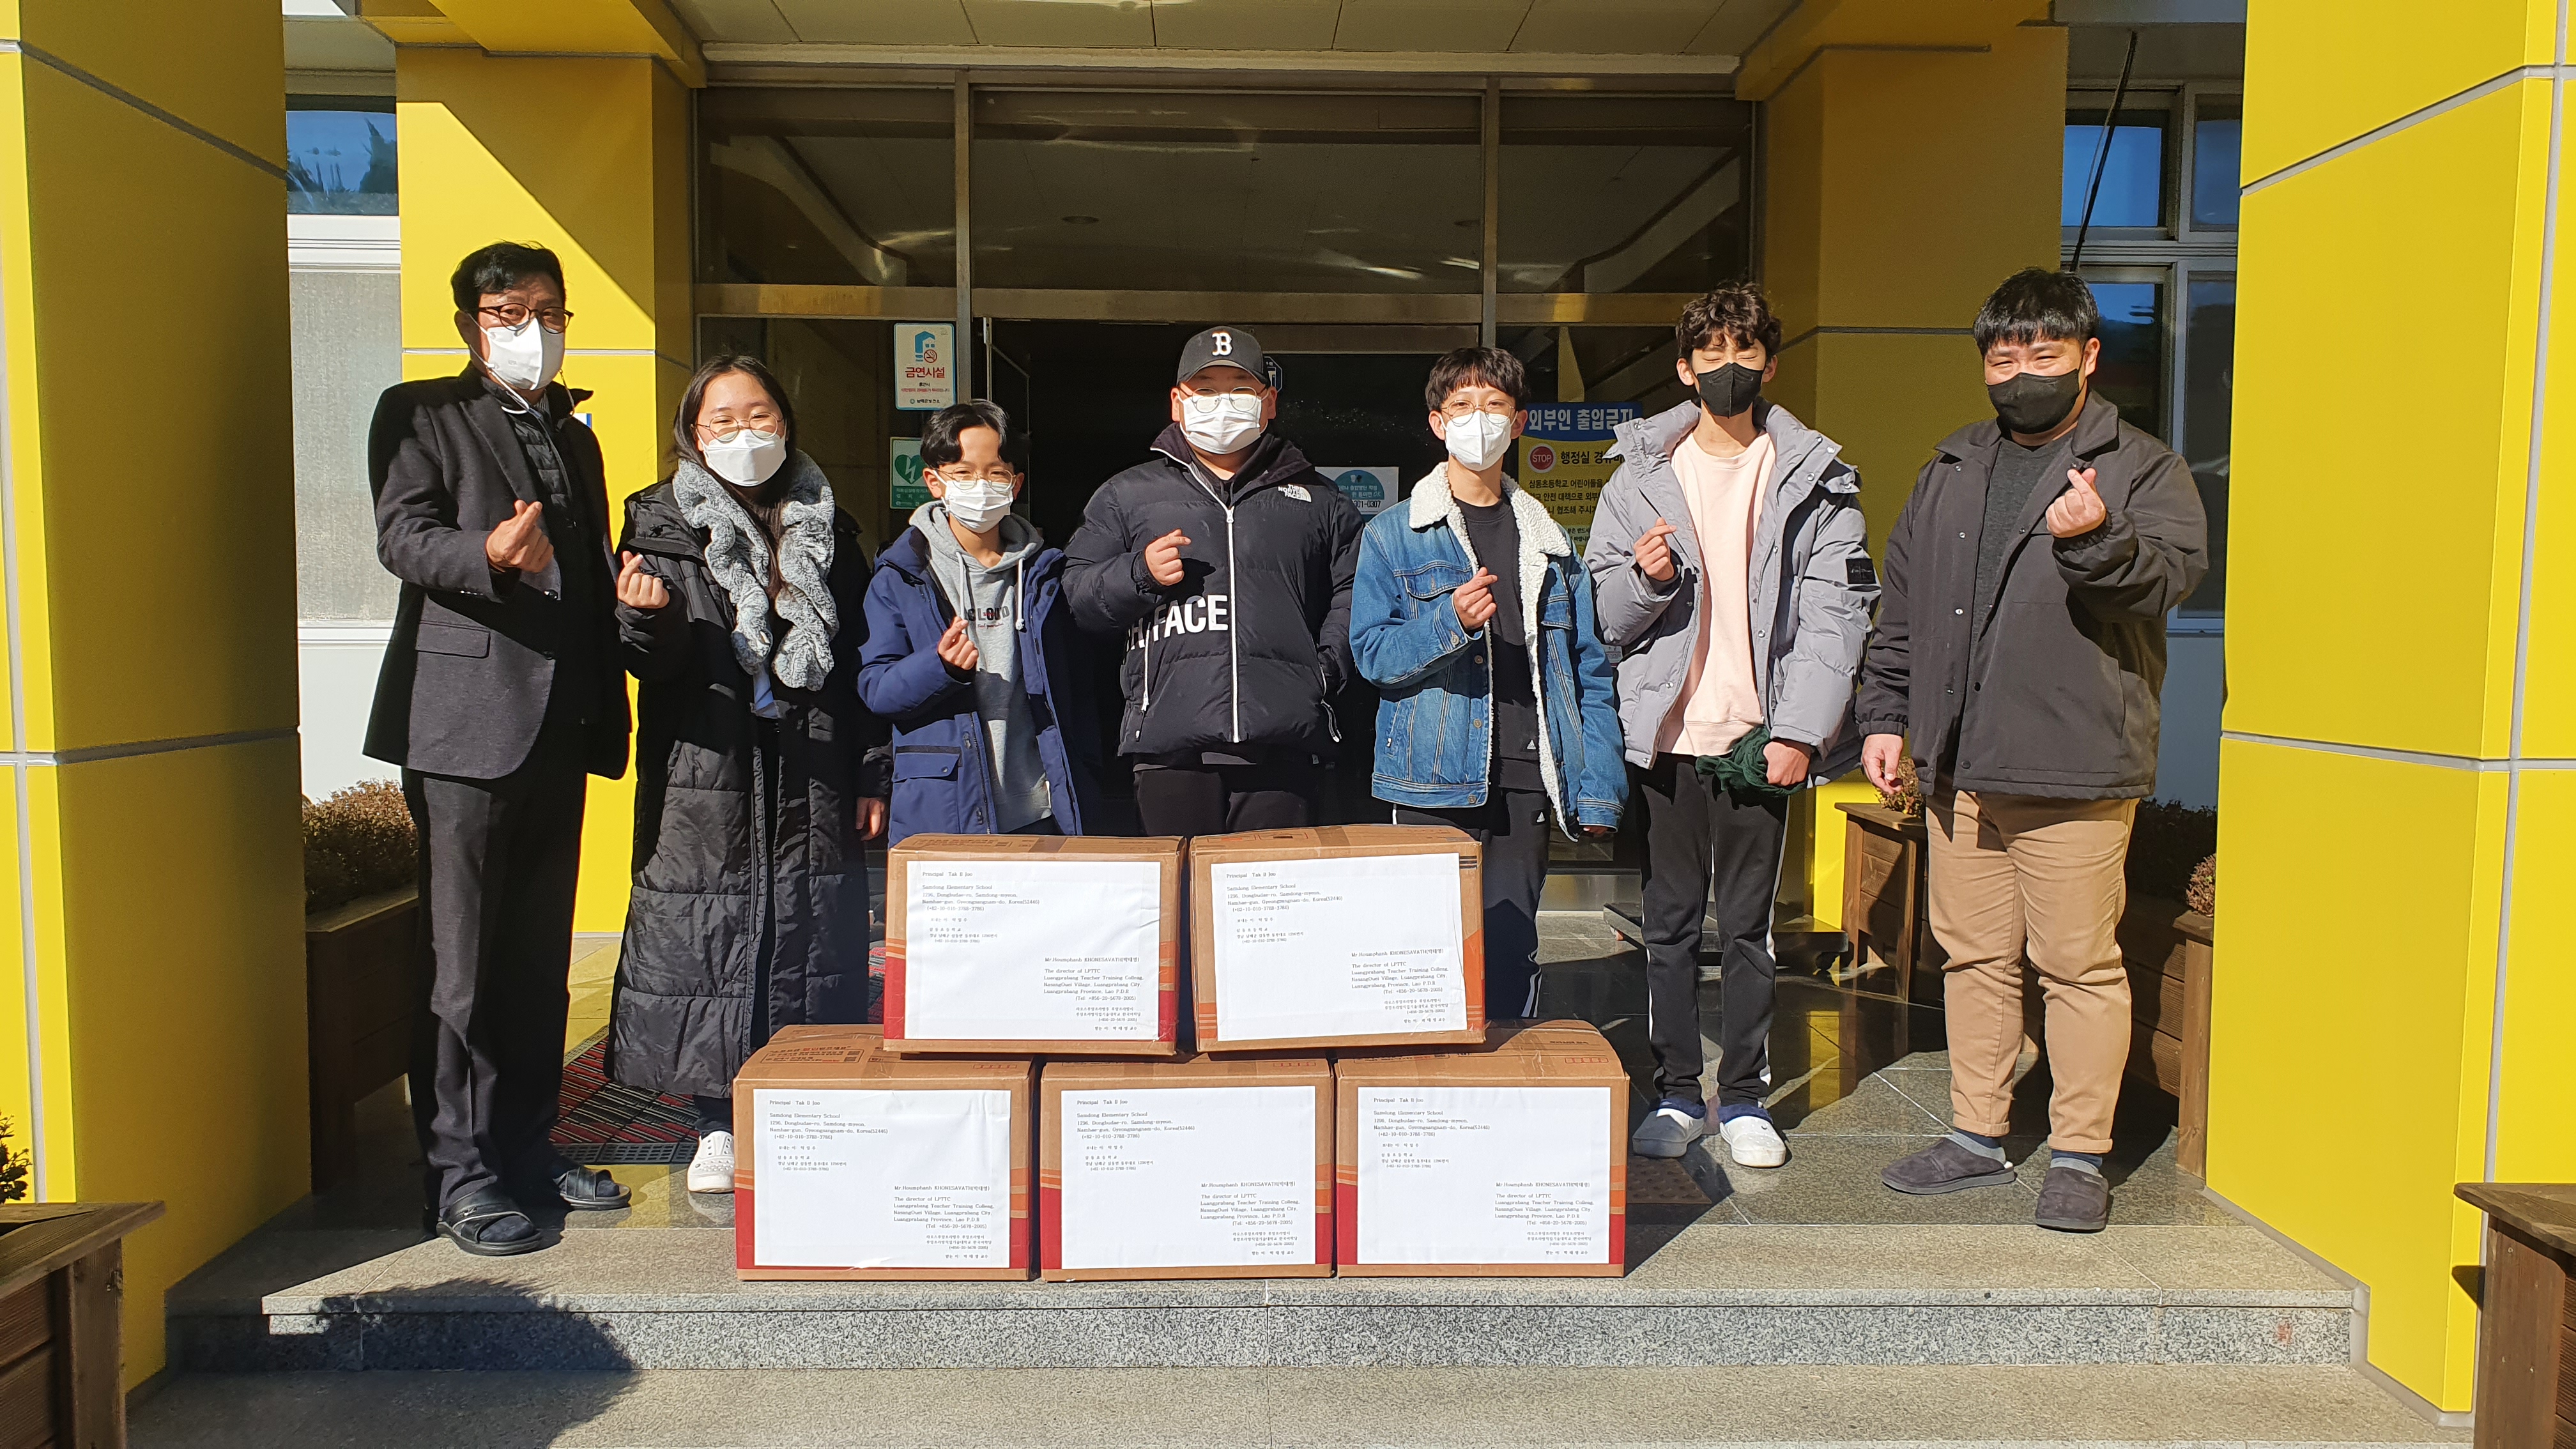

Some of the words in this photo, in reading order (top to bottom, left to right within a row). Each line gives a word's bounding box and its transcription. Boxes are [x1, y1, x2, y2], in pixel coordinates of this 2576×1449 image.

[1212, 332, 1232, 356] B
[905, 367, 946, 378] 금연시설
[1529, 410, 1570, 431] 외부인
[1577, 409, 1633, 431] 출입금지
[1533, 454, 1552, 463] STOP
[1561, 451, 1590, 464] 행정실
[1529, 479, 1569, 488] 삼동초등학교
[1544, 493, 1556, 502] 안전
[1586, 493, 1600, 501] 외부
[1153, 595, 1229, 641] FACE
